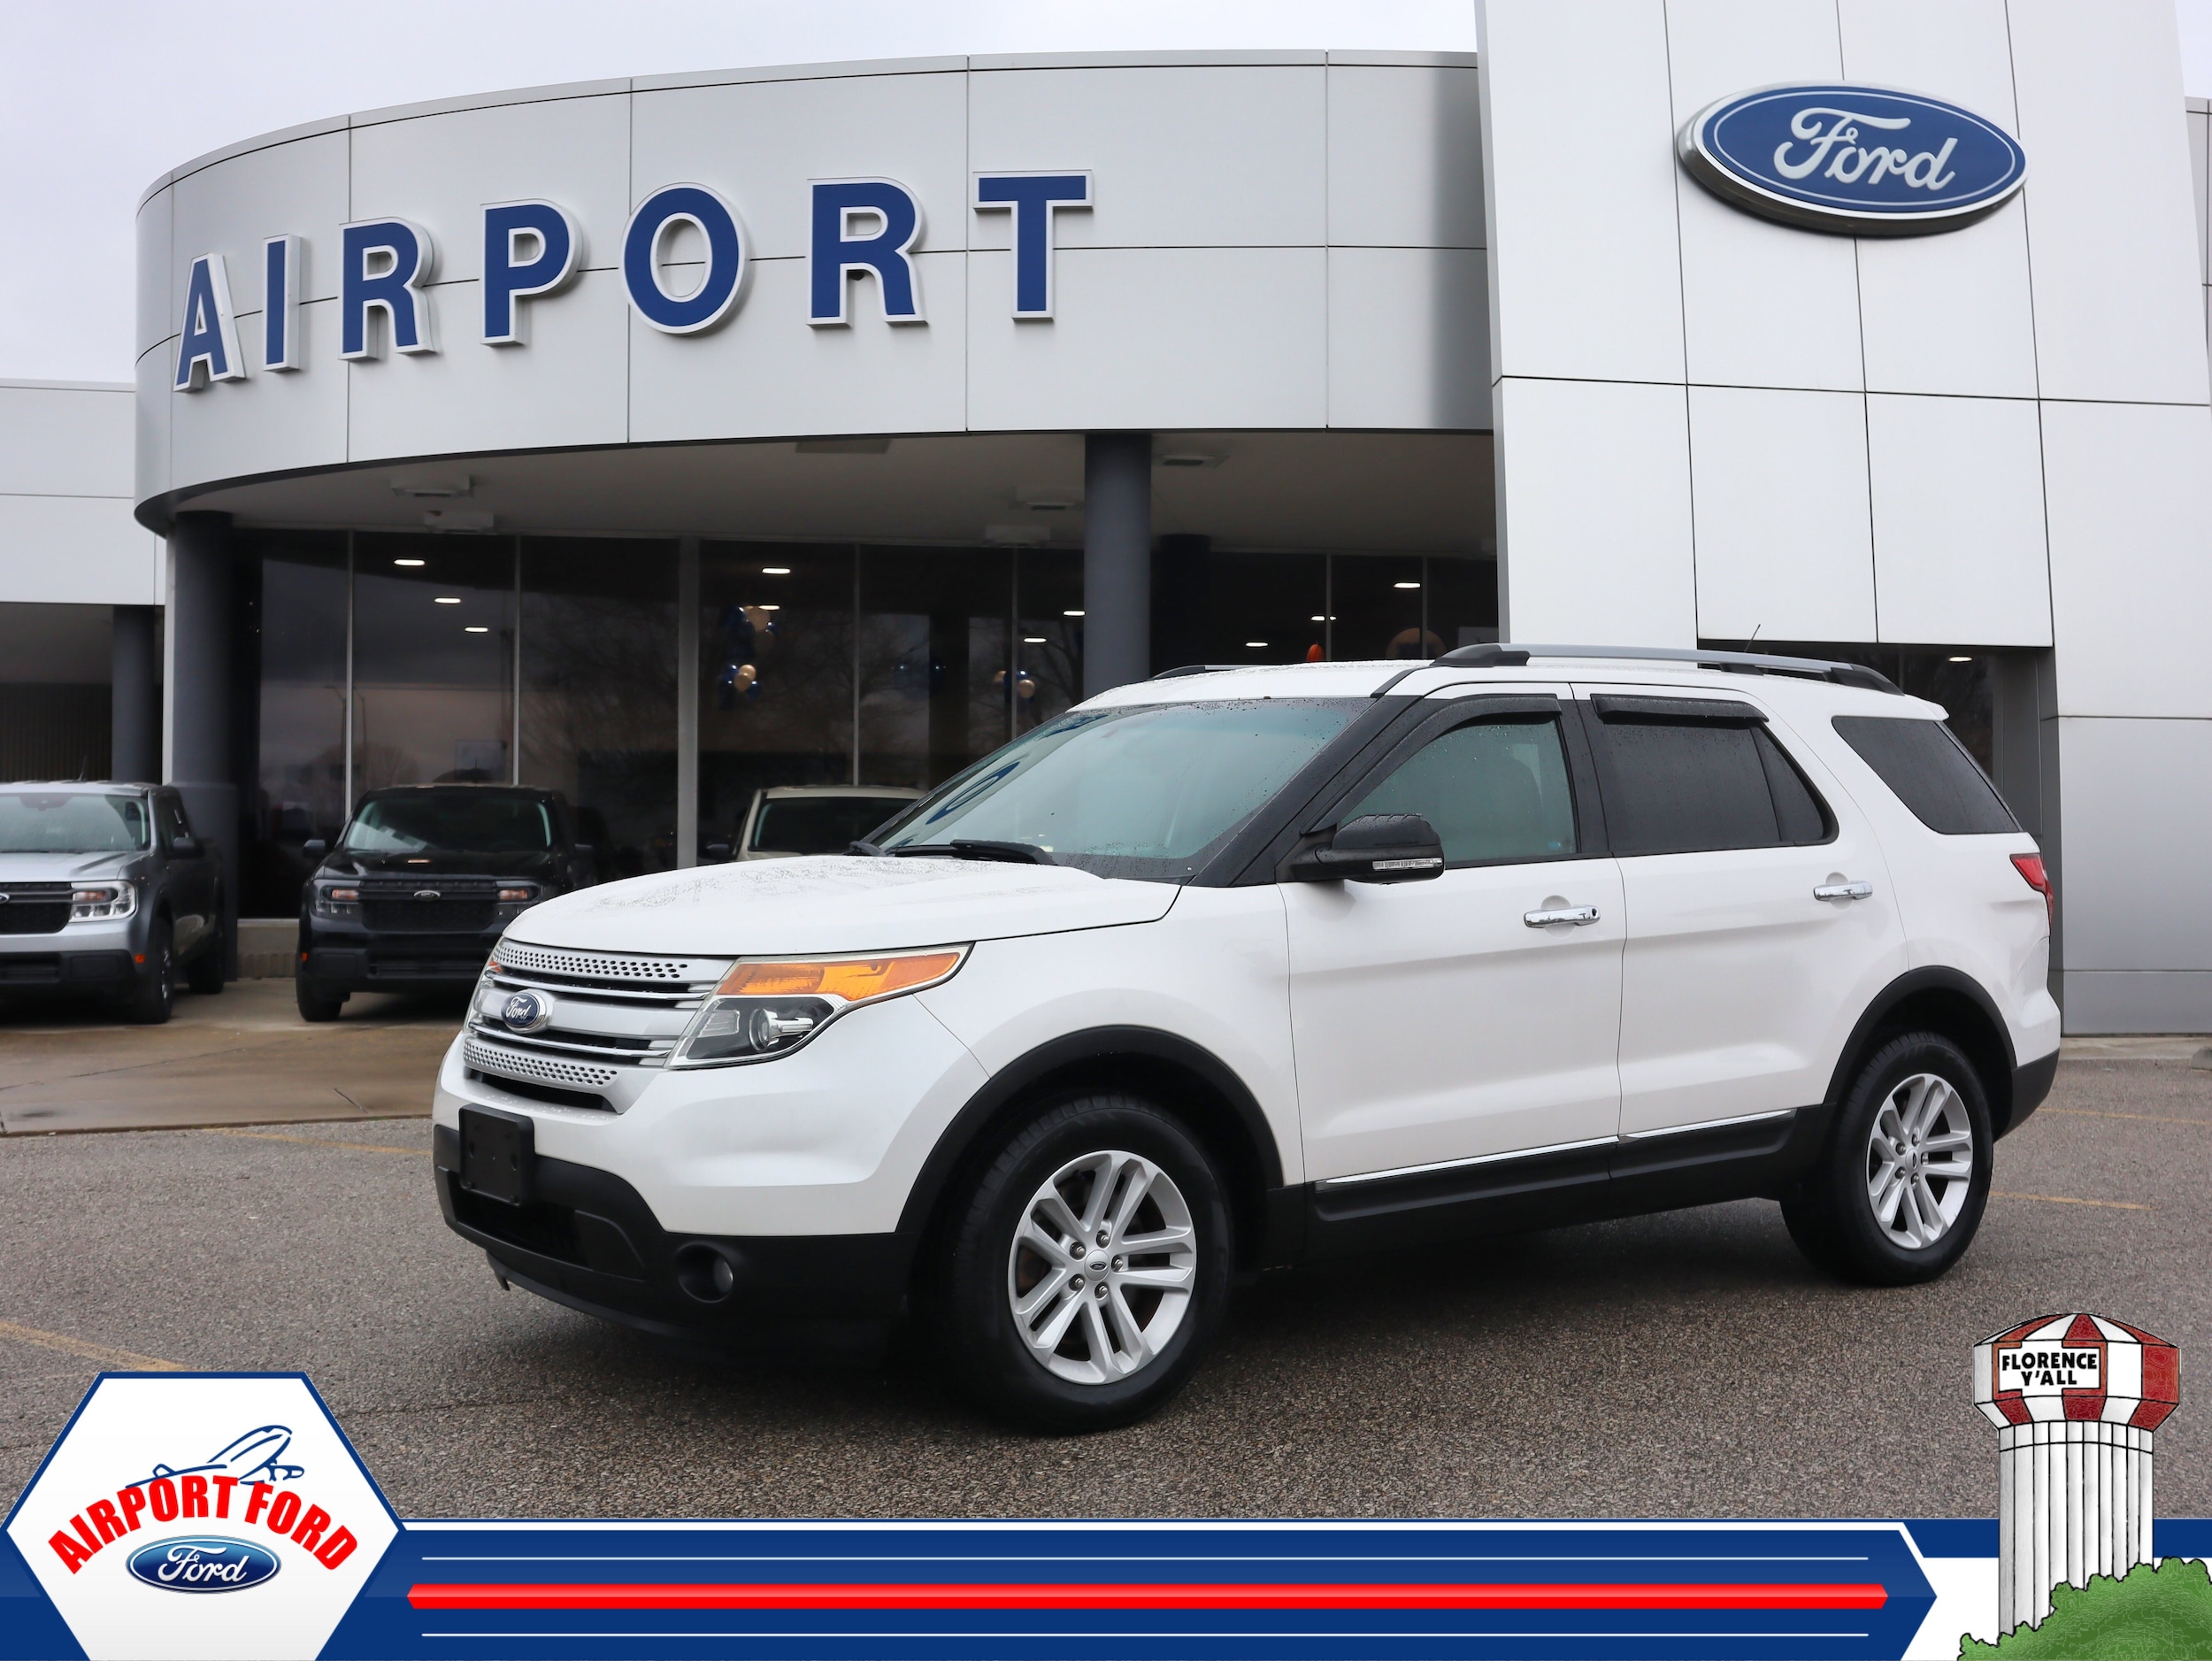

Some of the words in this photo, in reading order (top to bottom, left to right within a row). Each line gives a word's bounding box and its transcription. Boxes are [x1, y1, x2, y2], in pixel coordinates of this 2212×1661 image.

[1773, 107, 1956, 191] Ford
[172, 170, 1094, 393] AIRPORT
[505, 996, 532, 1019] Ford
